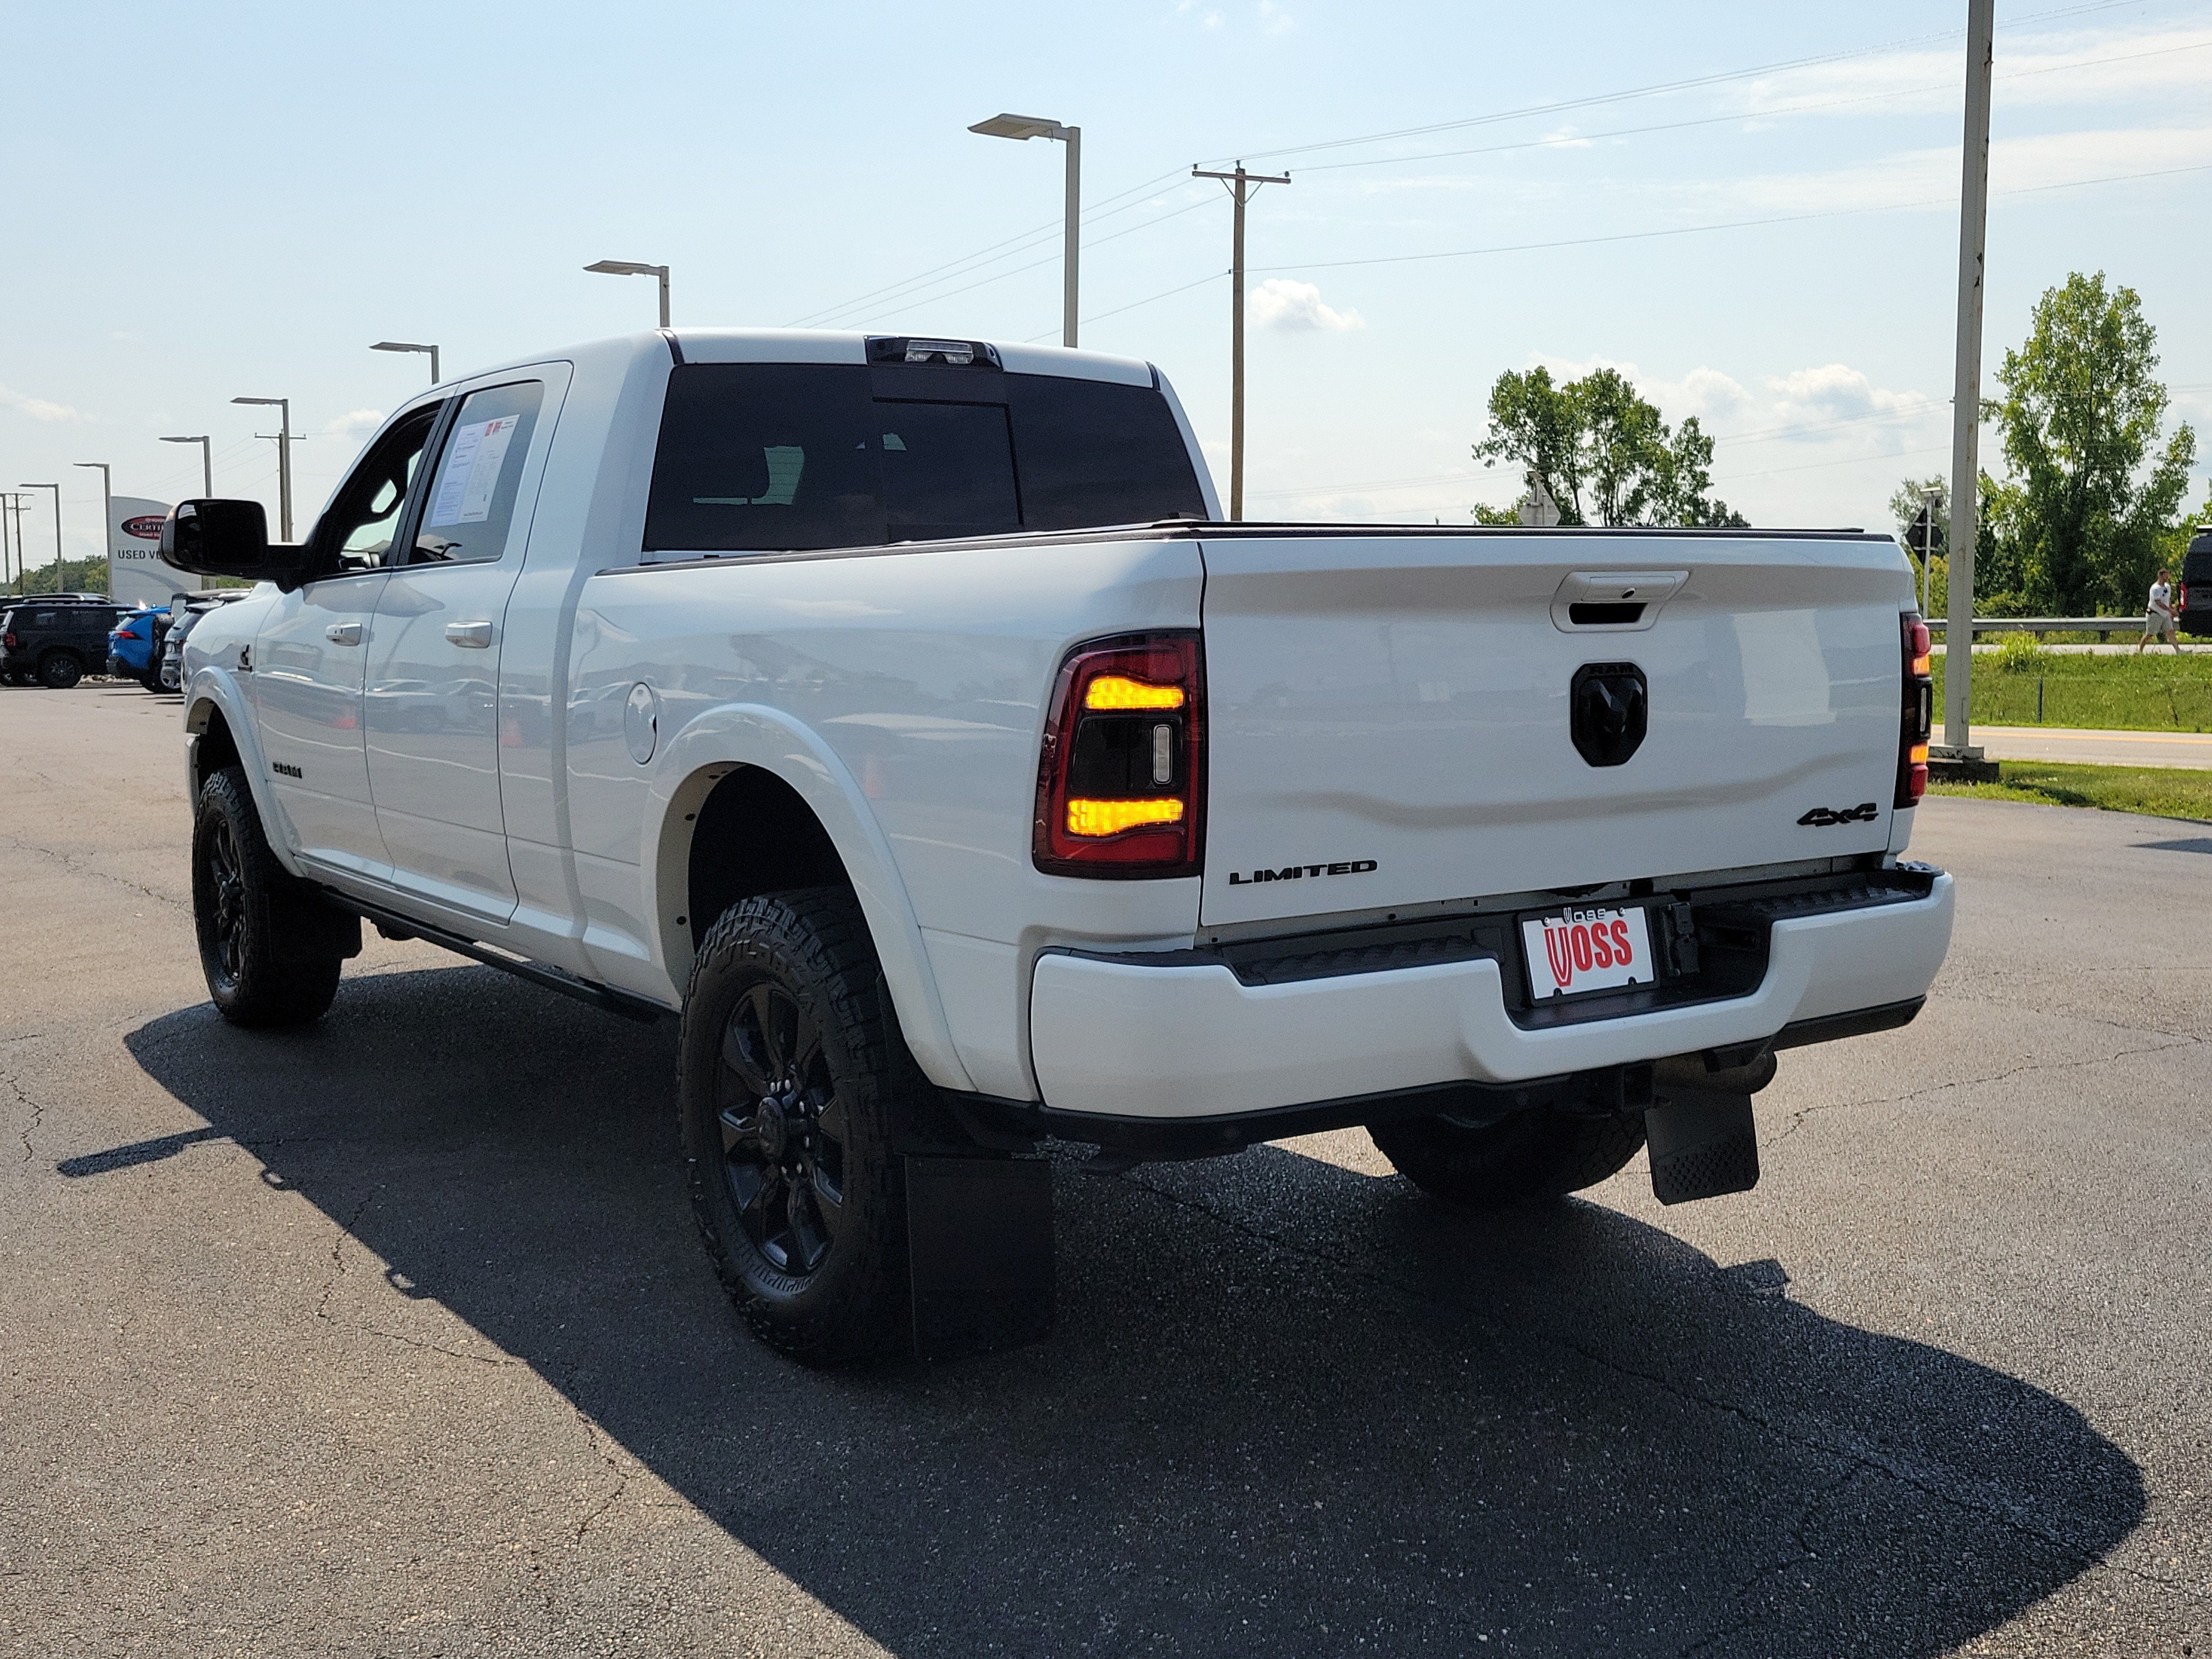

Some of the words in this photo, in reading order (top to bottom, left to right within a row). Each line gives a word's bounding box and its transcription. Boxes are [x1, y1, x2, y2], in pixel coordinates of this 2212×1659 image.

[118, 550, 145, 559] USED
[1589, 664, 1633, 674] RAM
[1229, 860, 1378, 885] LIMITED
[1544, 920, 1633, 987] VOSS
